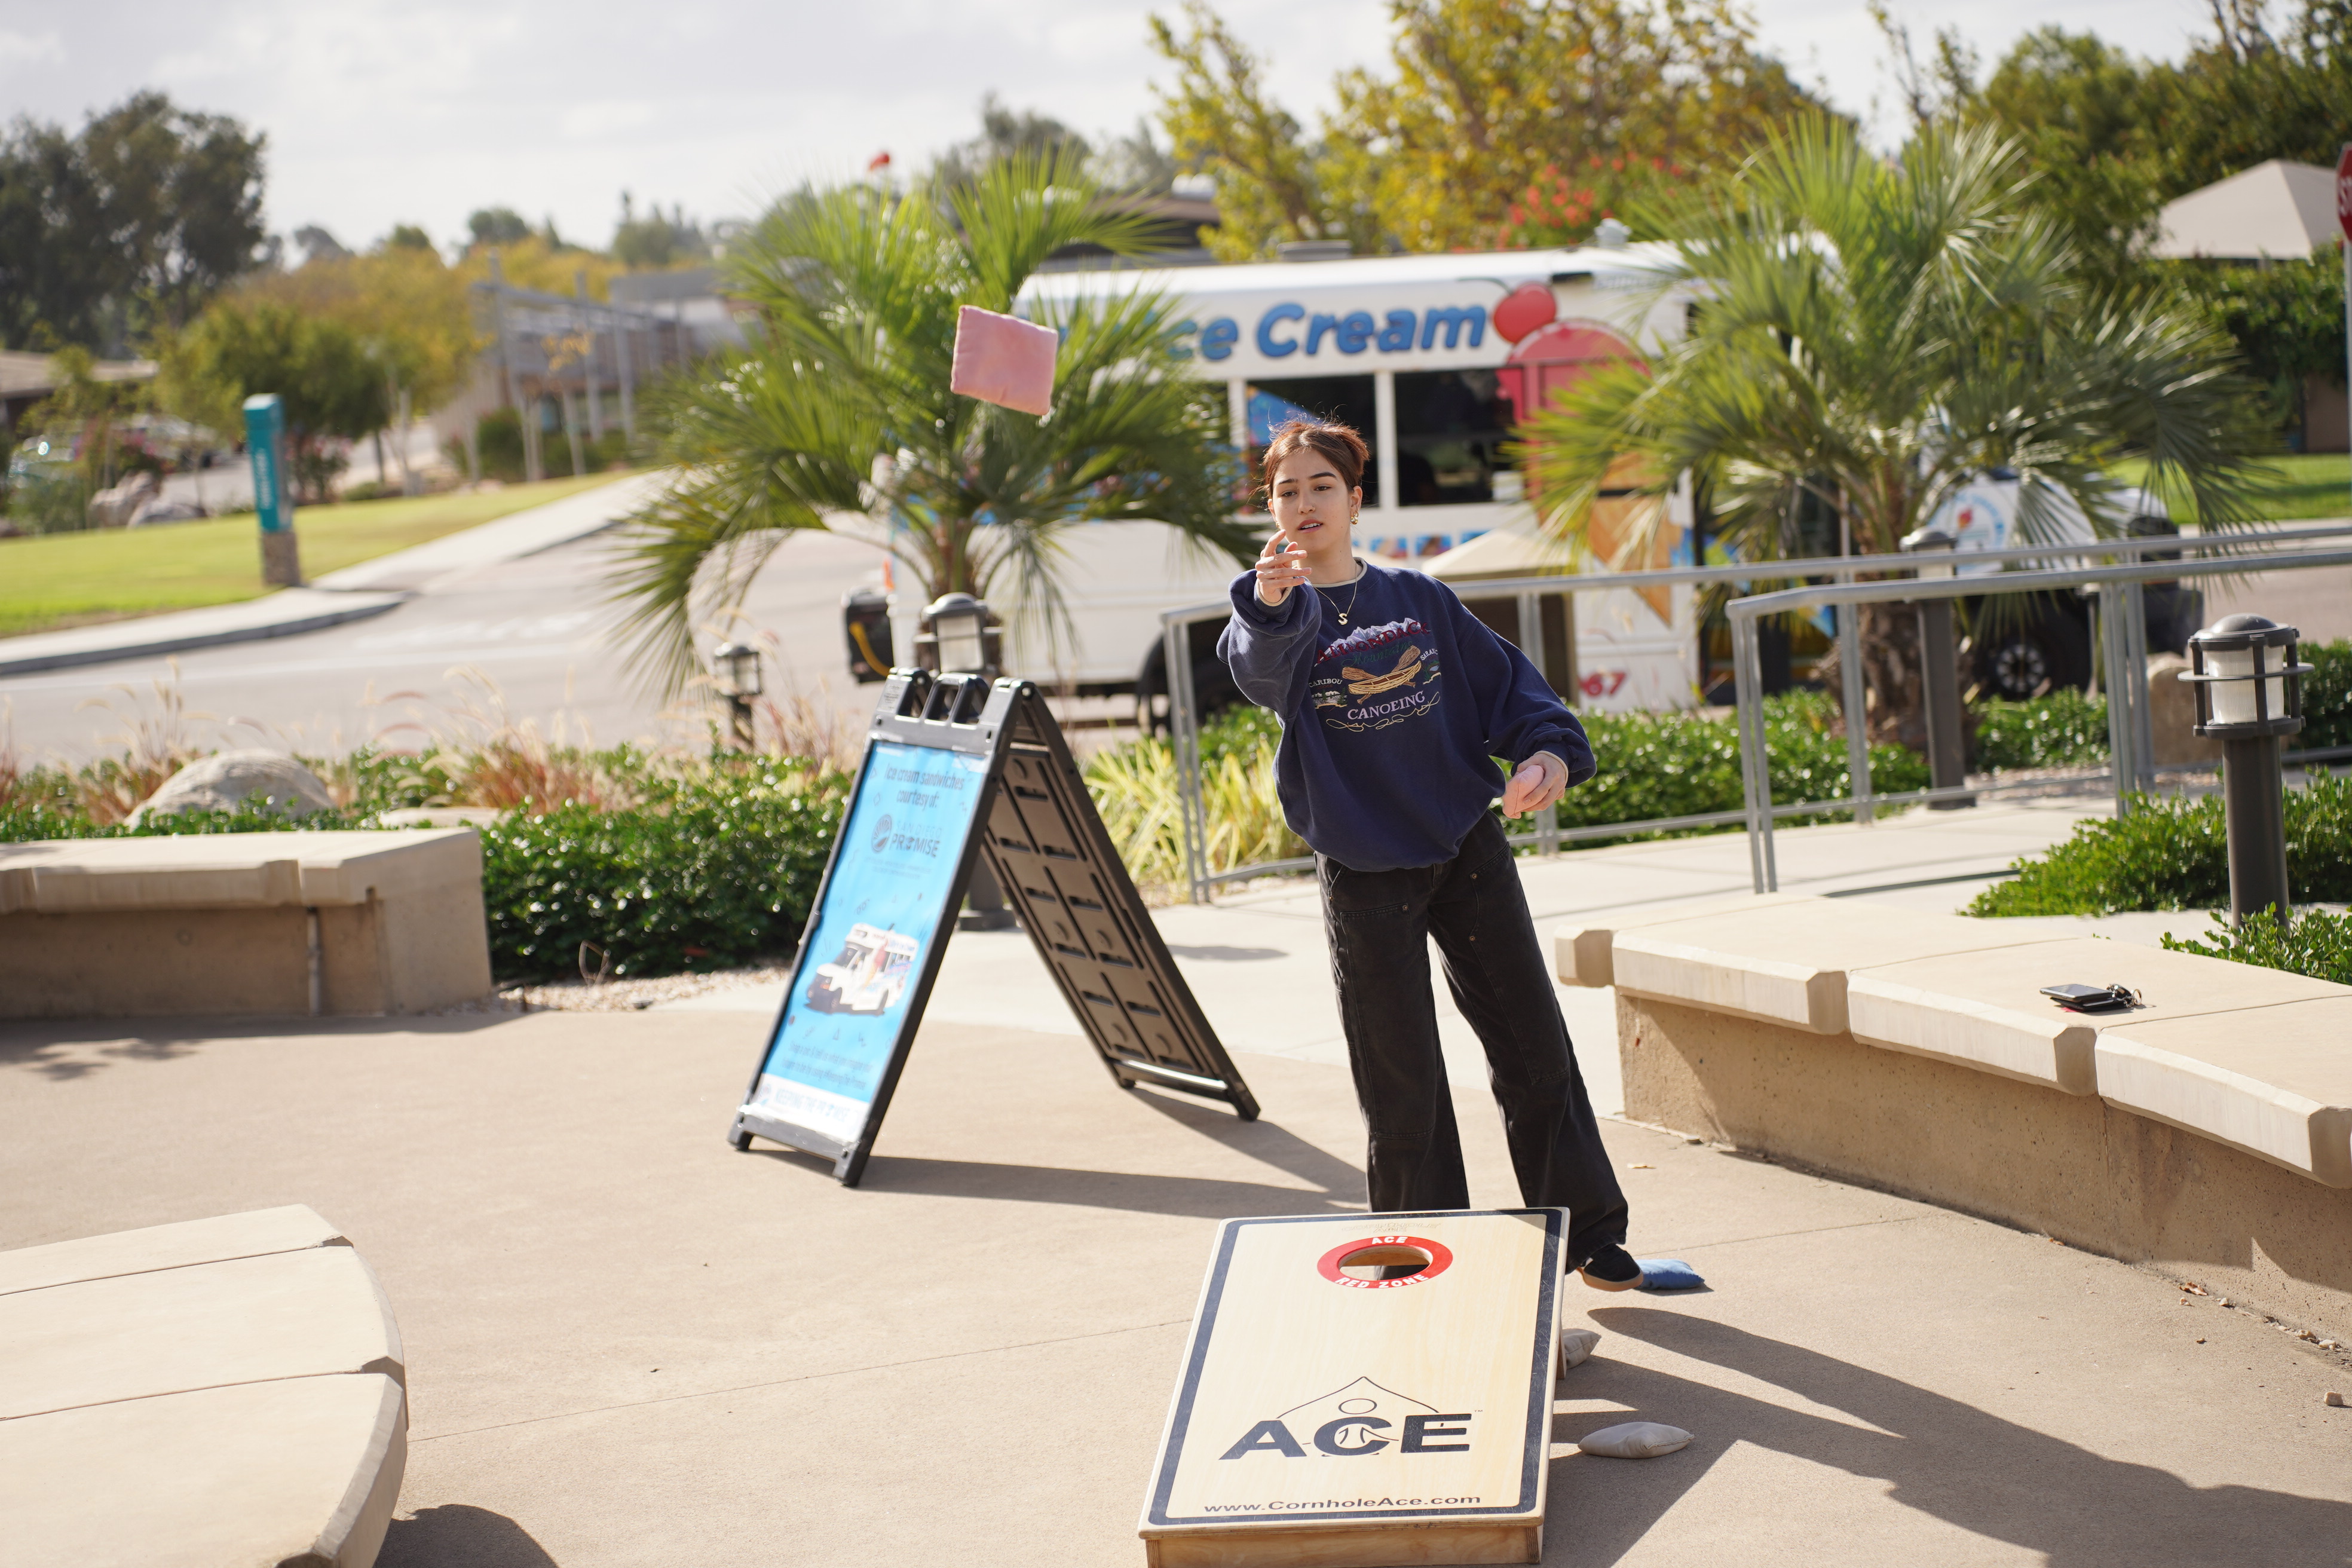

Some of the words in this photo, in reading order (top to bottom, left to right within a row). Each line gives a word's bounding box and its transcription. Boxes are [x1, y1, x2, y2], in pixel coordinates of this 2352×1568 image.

[1256, 302, 1487, 357] Cream
[1309, 678, 1343, 688] CARIBOU
[1348, 691, 1425, 720] CANOEING
[897, 768, 920, 785] cream
[920, 771, 966, 790] sandwiches
[896, 789, 929, 811] courtesy
[897, 819, 913, 834] SAN
[915, 825, 943, 840] DIEGO
[1371, 1236, 1408, 1245] ACE
[1334, 1277, 1370, 1288] RED
[1379, 1274, 1429, 1288] ZONE
[1218, 1413, 1472, 1460] ACE
[1203, 1495, 1481, 1513] www.CornholeAce.com
